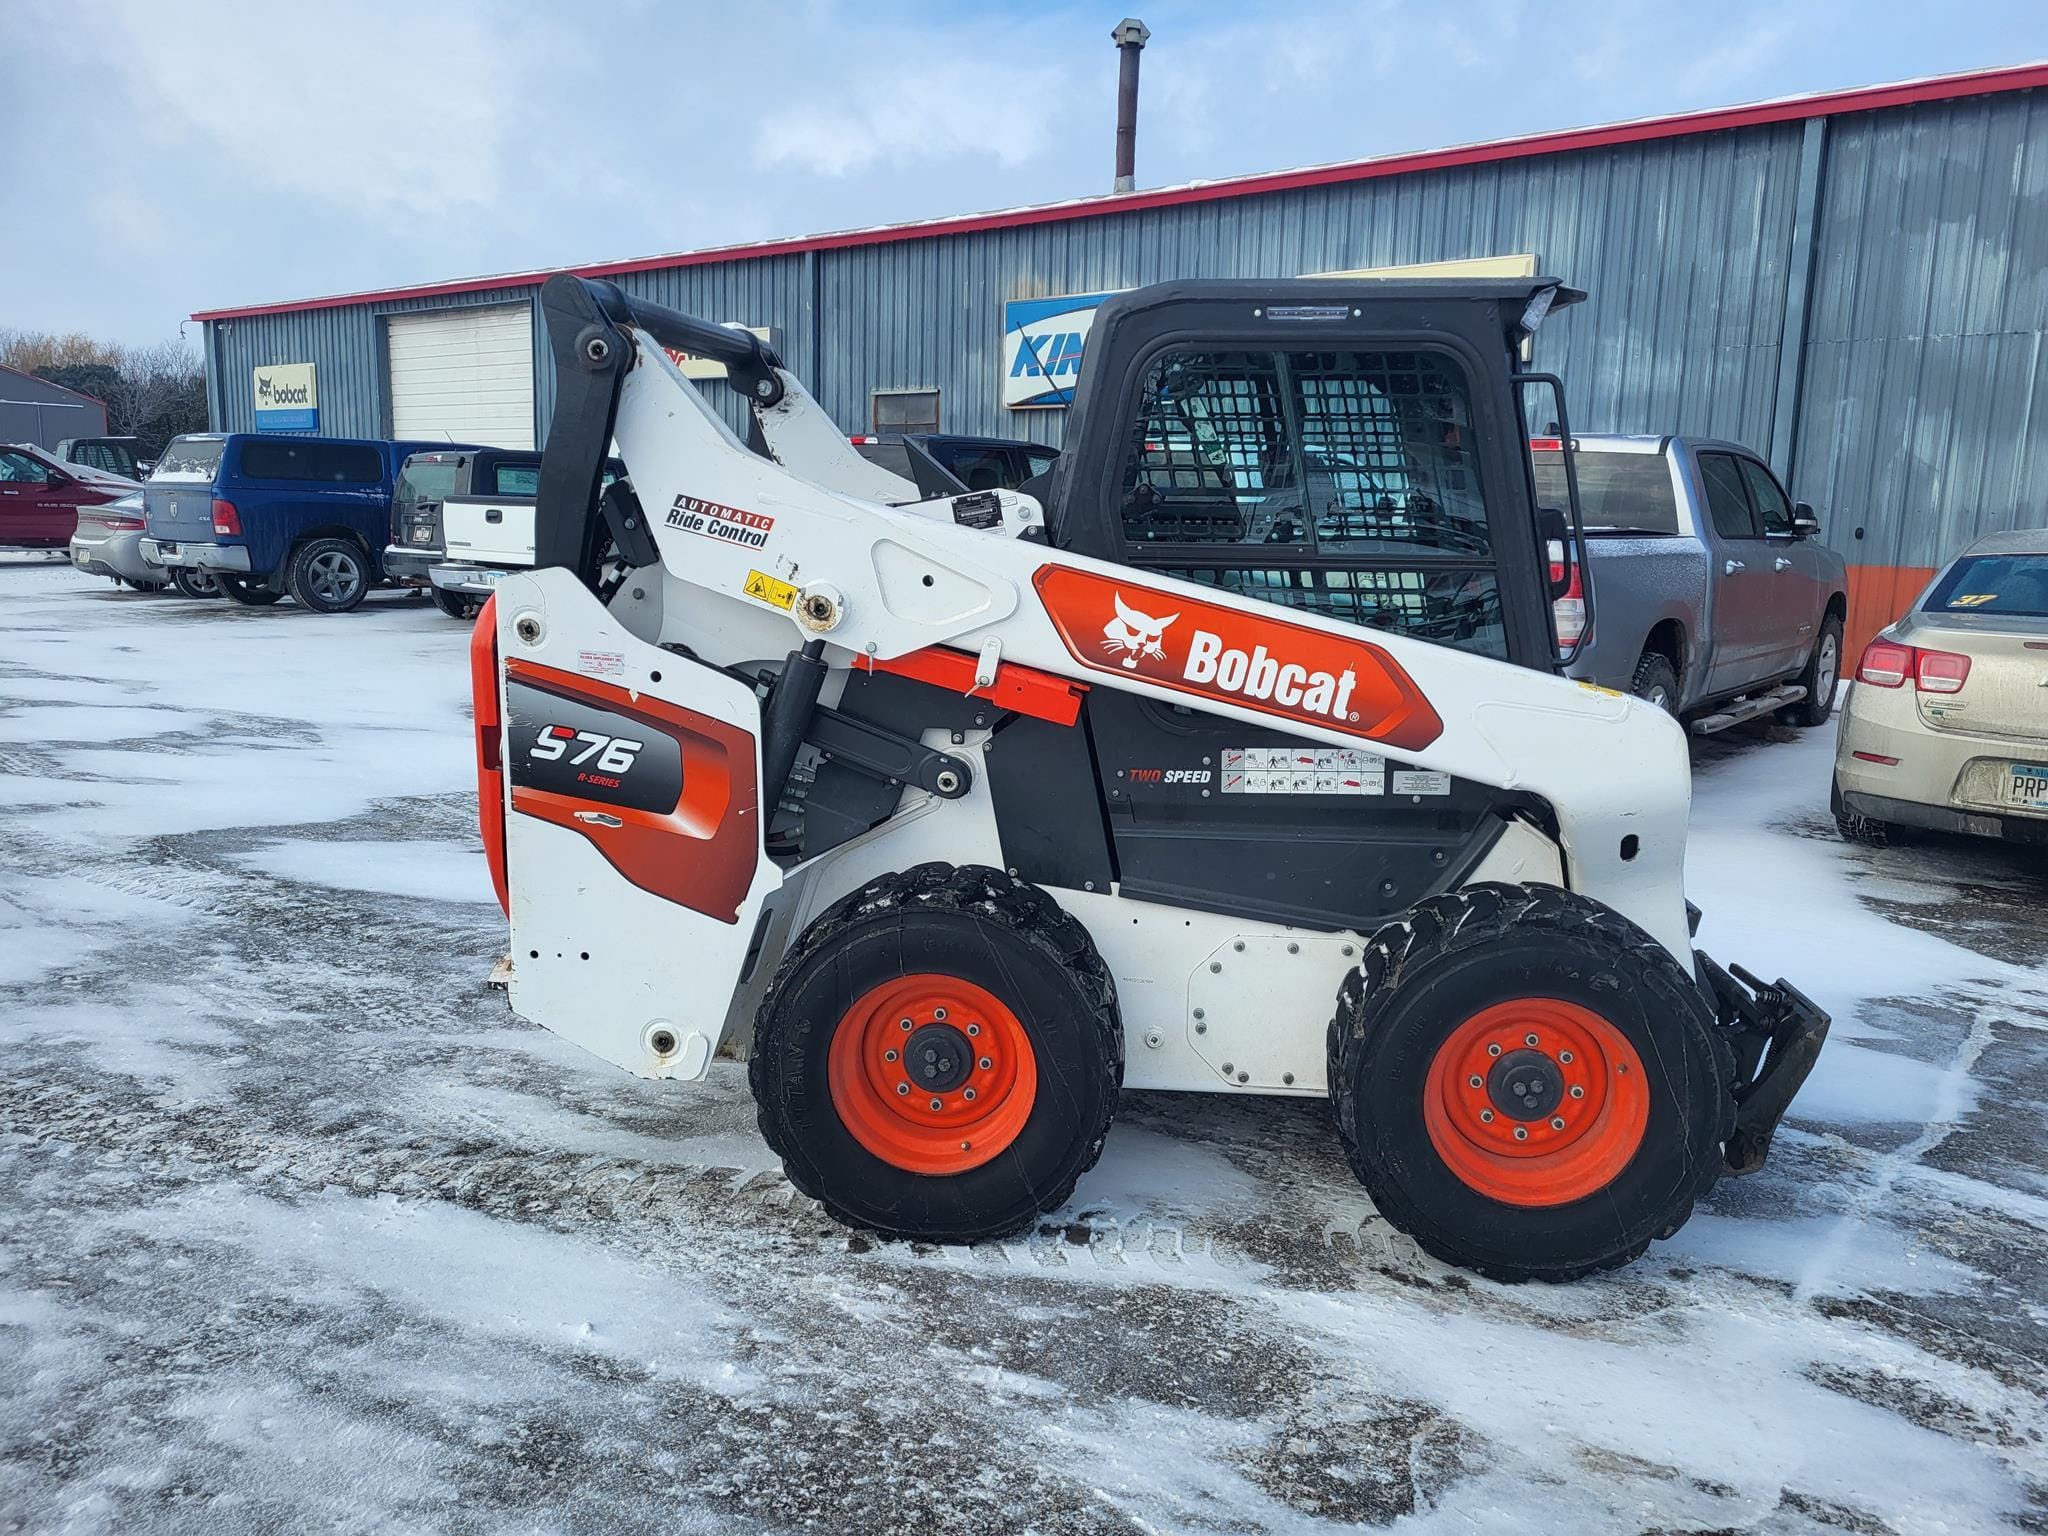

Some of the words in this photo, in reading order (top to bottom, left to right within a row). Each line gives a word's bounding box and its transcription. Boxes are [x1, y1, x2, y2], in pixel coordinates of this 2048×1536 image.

[273, 383, 308, 404] bobcat
[678, 497, 769, 529] AUTOMATIC
[666, 509, 704, 530] Ride
[707, 519, 768, 547] Control
[1951, 595, 1998, 605] 37
[1184, 630, 1356, 720] Bobcat
[530, 725, 642, 773] S76
[577, 772, 621, 788] R-SERIES
[1130, 769, 1161, 783] TWO
[1164, 770, 1211, 783] SPEED
